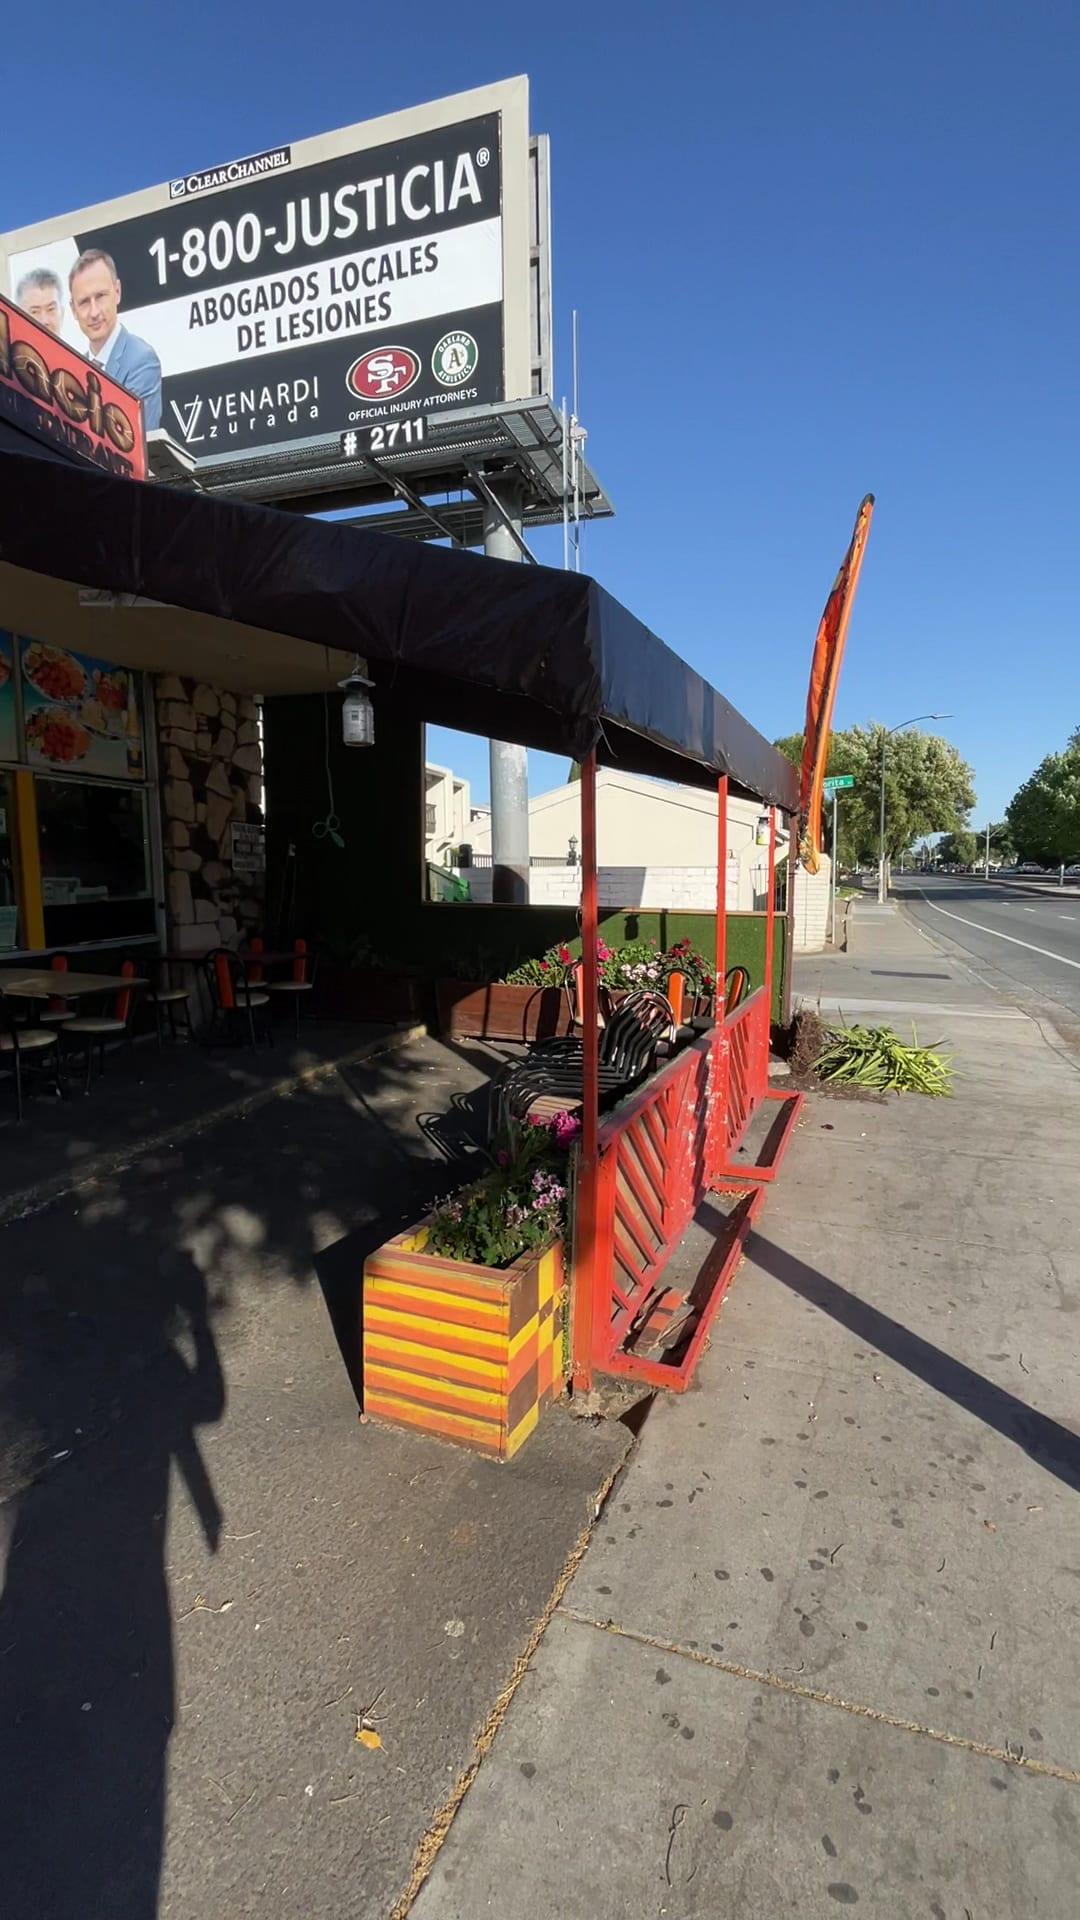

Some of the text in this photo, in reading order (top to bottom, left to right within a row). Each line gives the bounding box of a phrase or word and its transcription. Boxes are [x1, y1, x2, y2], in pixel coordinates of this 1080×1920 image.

[188, 241, 439, 330] ABOGADOS LOCALES
[237, 291, 392, 353] DE LESIONES
[438, 334, 471, 353] OAKLAND
[437, 363, 472, 383] ATHLETICS
[208, 375, 318, 420] VENARDI
[348, 388, 478, 422] OFFICIAL INJURY ATTORNEYS
[209, 405, 319, 438] zurada
[343, 417, 424, 456] # 2711
